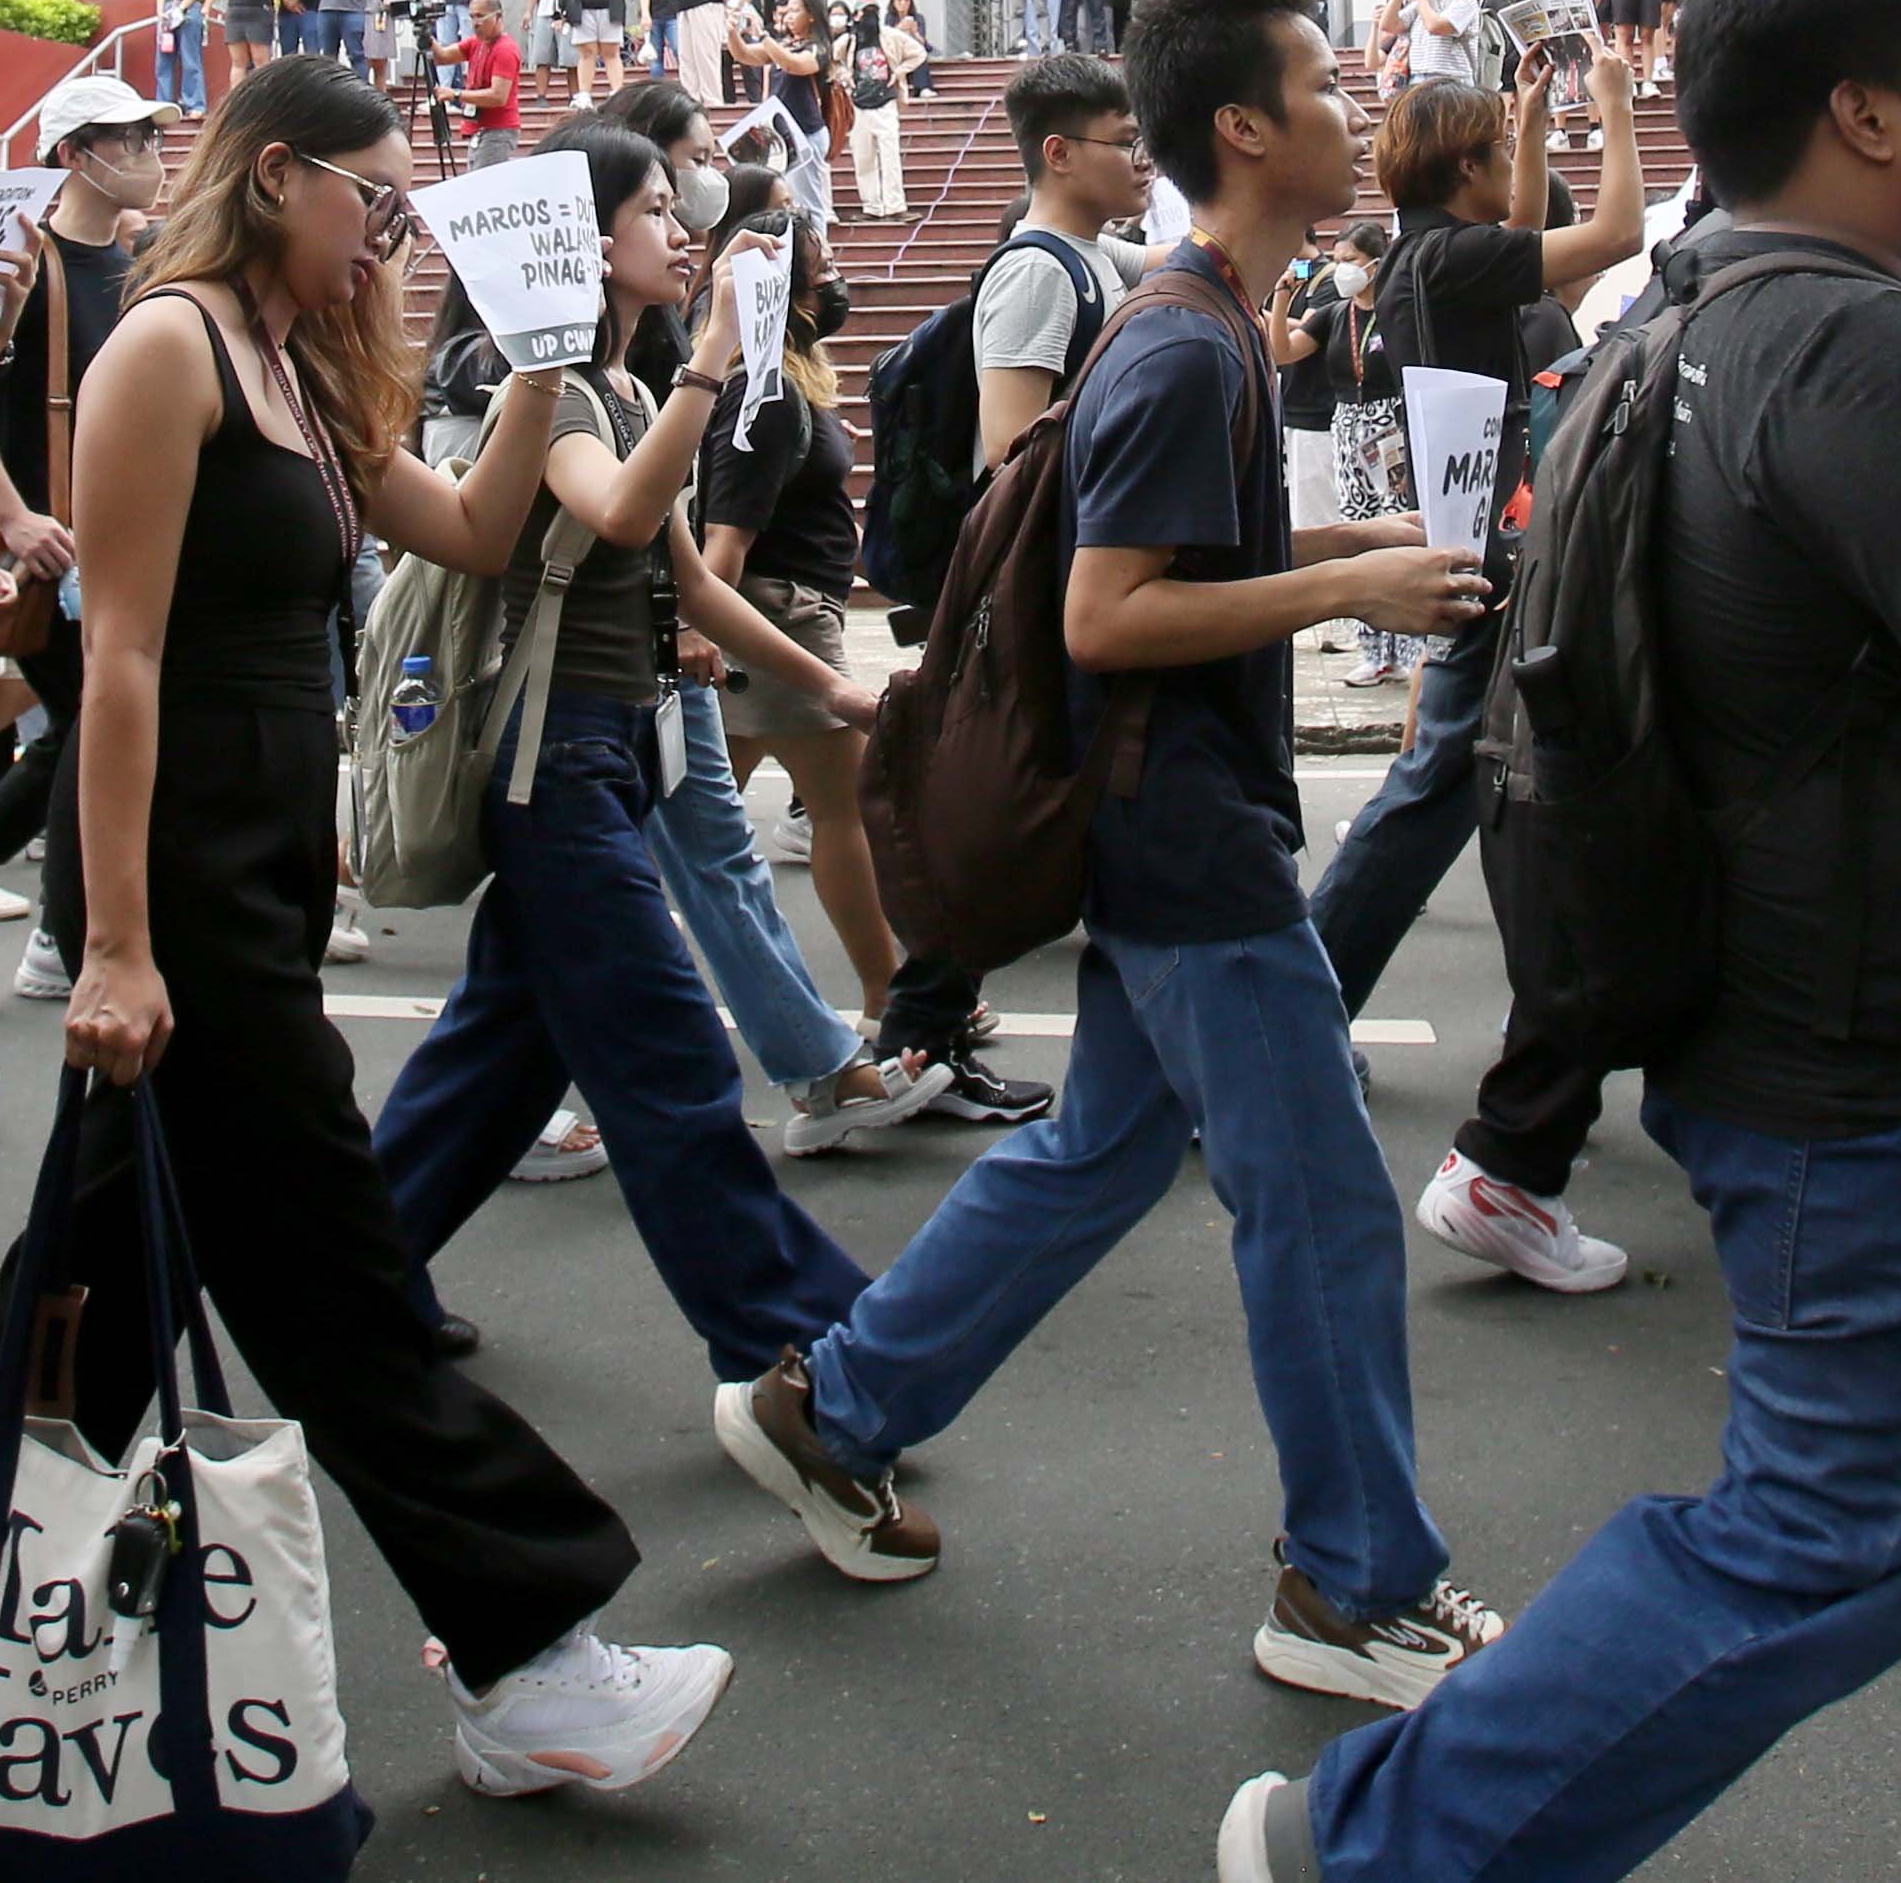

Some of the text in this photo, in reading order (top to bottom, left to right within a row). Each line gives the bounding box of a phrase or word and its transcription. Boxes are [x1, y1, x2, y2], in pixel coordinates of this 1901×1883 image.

[449, 199, 552, 244] MARCOS
[531, 332, 559, 359] UP
[604, 393, 629, 440] COLLEGE
[52, 1670, 120, 1706] PERRY
